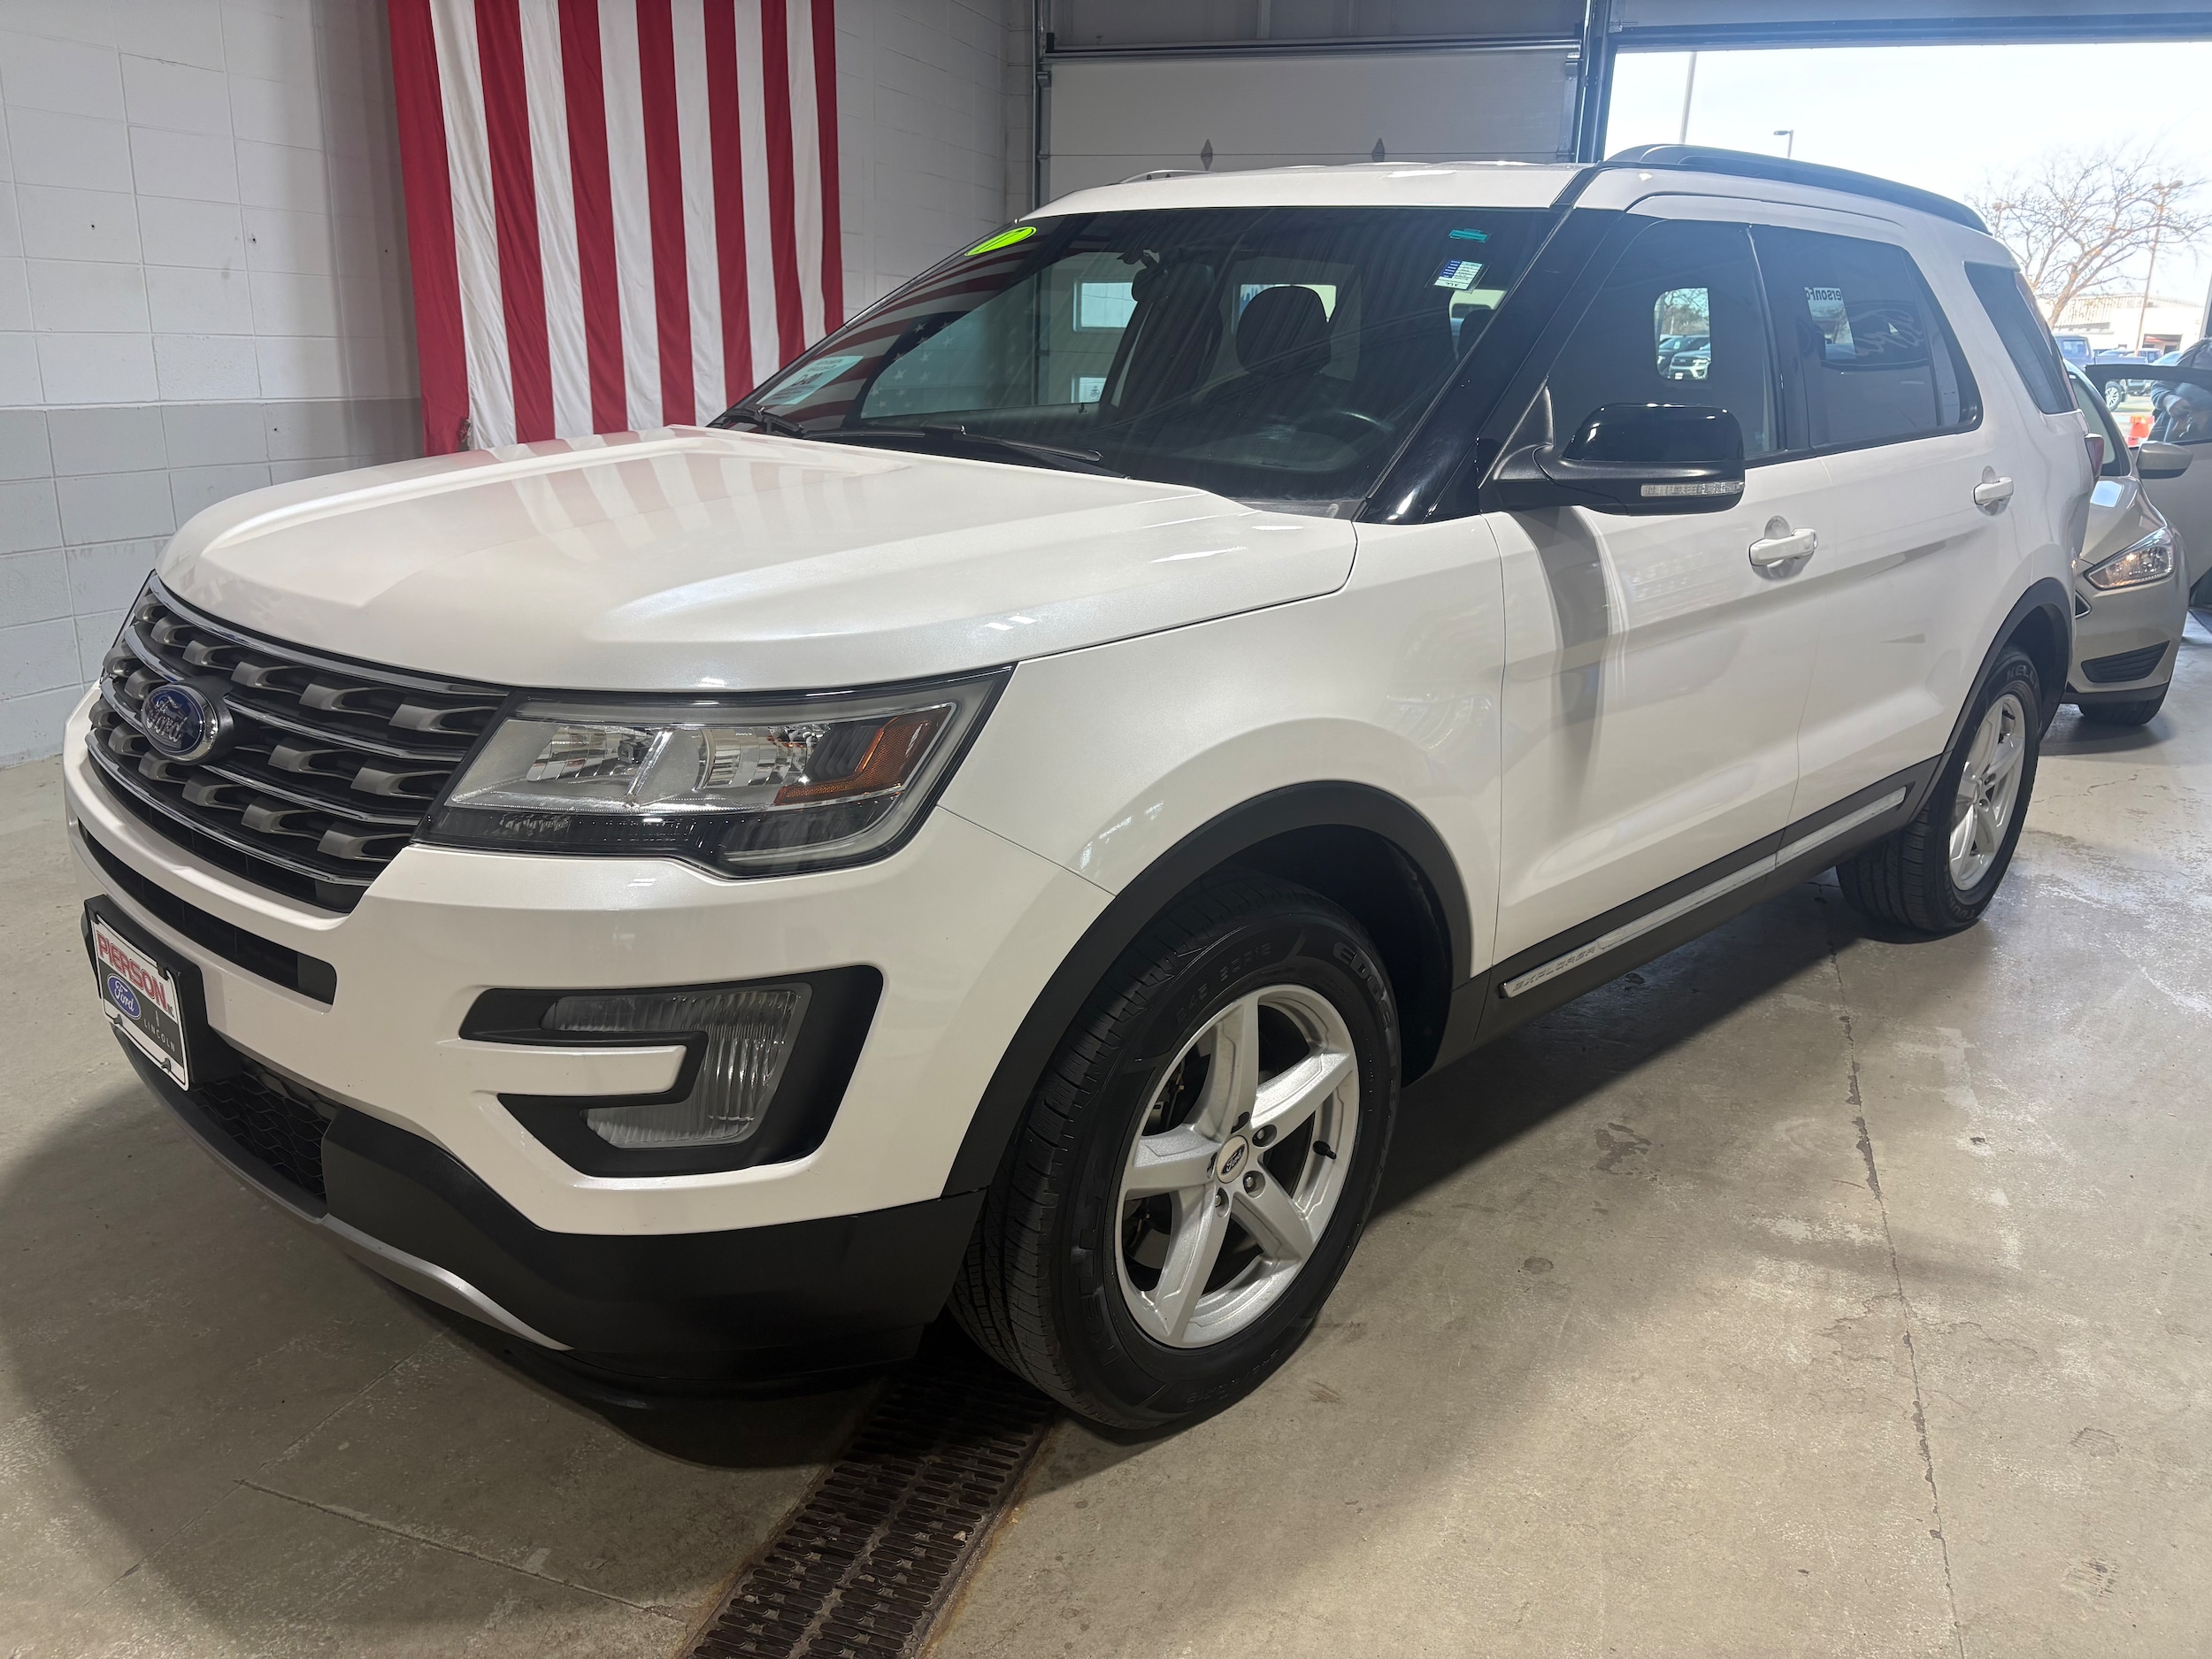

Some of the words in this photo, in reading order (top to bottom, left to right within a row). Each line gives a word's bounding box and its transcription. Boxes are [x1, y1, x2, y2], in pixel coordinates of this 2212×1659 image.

[96, 932, 169, 1014] PIERSON
[1512, 946, 1596, 992] EXPLORER
[114, 979, 134, 1012] Ford
[142, 1018, 175, 1053] LINCOLN
[1225, 1149, 1242, 1171] Ford
